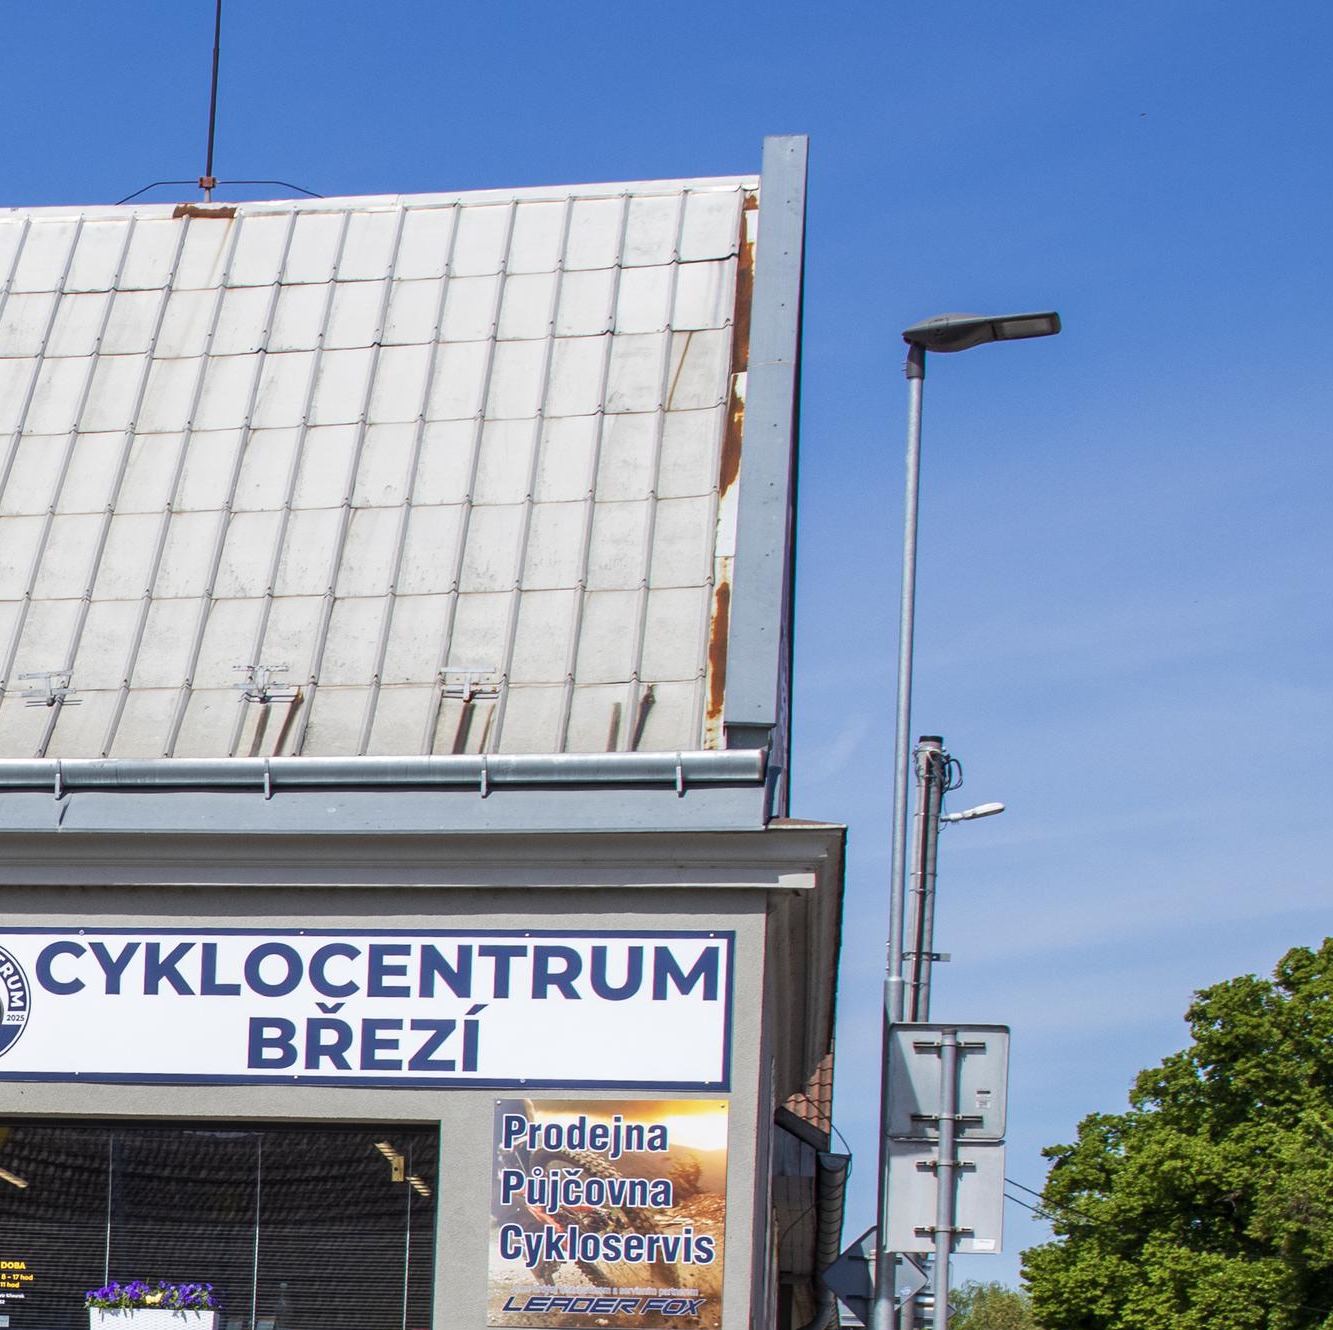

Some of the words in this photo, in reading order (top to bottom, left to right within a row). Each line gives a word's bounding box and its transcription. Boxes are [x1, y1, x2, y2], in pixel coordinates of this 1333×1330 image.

[34, 940, 719, 1002] CYKLOCENTRUM
[6, 1014, 25, 1022] 2025
[247, 1002, 489, 1073] BŘEZÍ
[503, 1114, 669, 1159] Prodejna
[501, 1167, 673, 1214] Půjčovna
[0, 1261, 27, 1270] DOBA
[499, 1223, 716, 1268] Cykloservis
[6, 1281, 20, 1289] hod
[501, 1295, 636, 1315] LEADER
[639, 1297, 708, 1316] FOX
